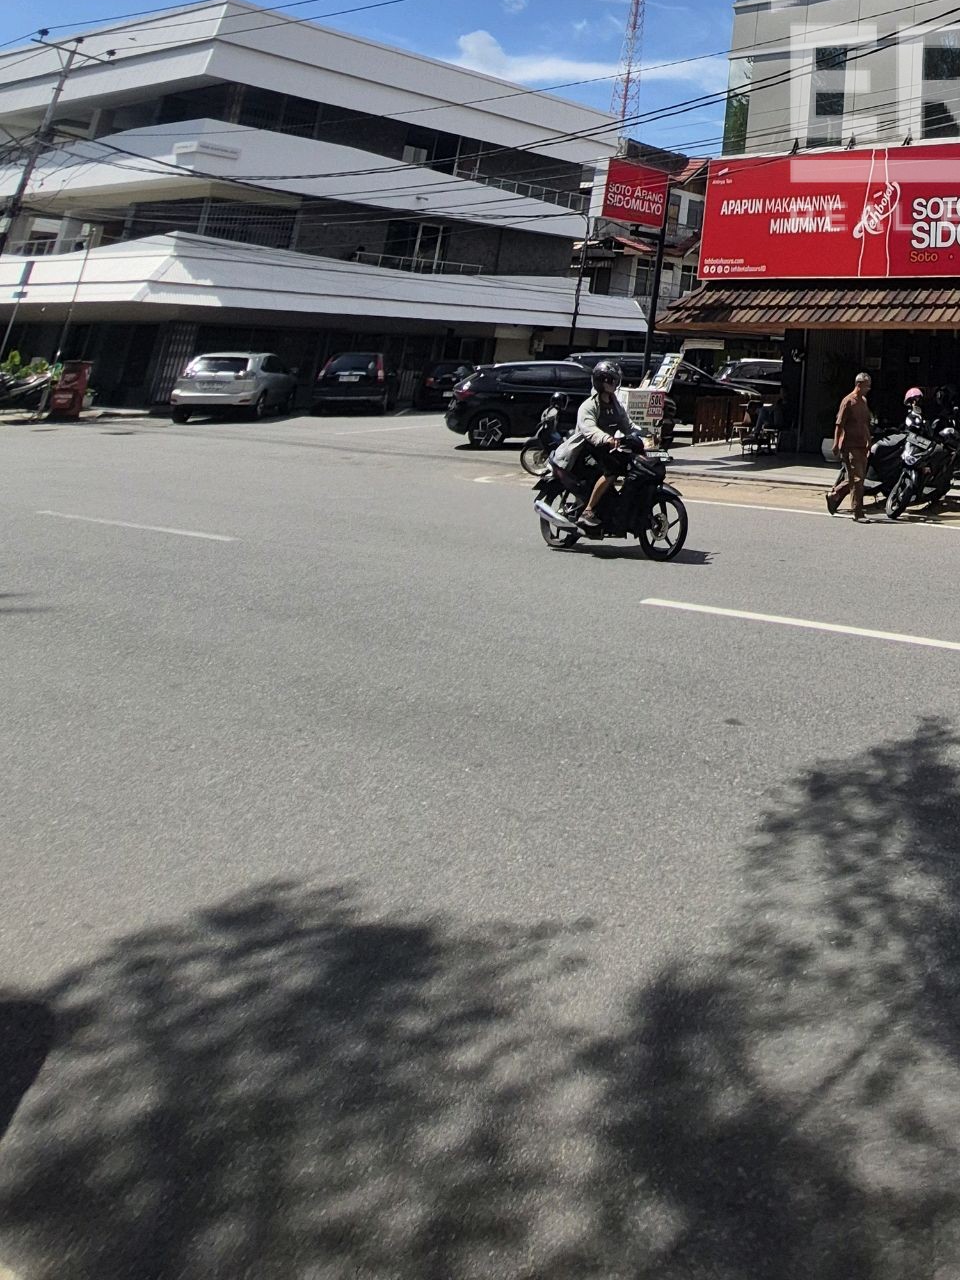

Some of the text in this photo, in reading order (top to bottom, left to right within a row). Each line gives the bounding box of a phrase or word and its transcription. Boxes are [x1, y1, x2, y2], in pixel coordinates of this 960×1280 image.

[606, 193, 662, 215] SIDOMULYO
[608, 182, 664, 204] SOTO ARANG
[720, 194, 842, 216] APAPUN MAKANANNYA
[910, 251, 938, 263] Soto
